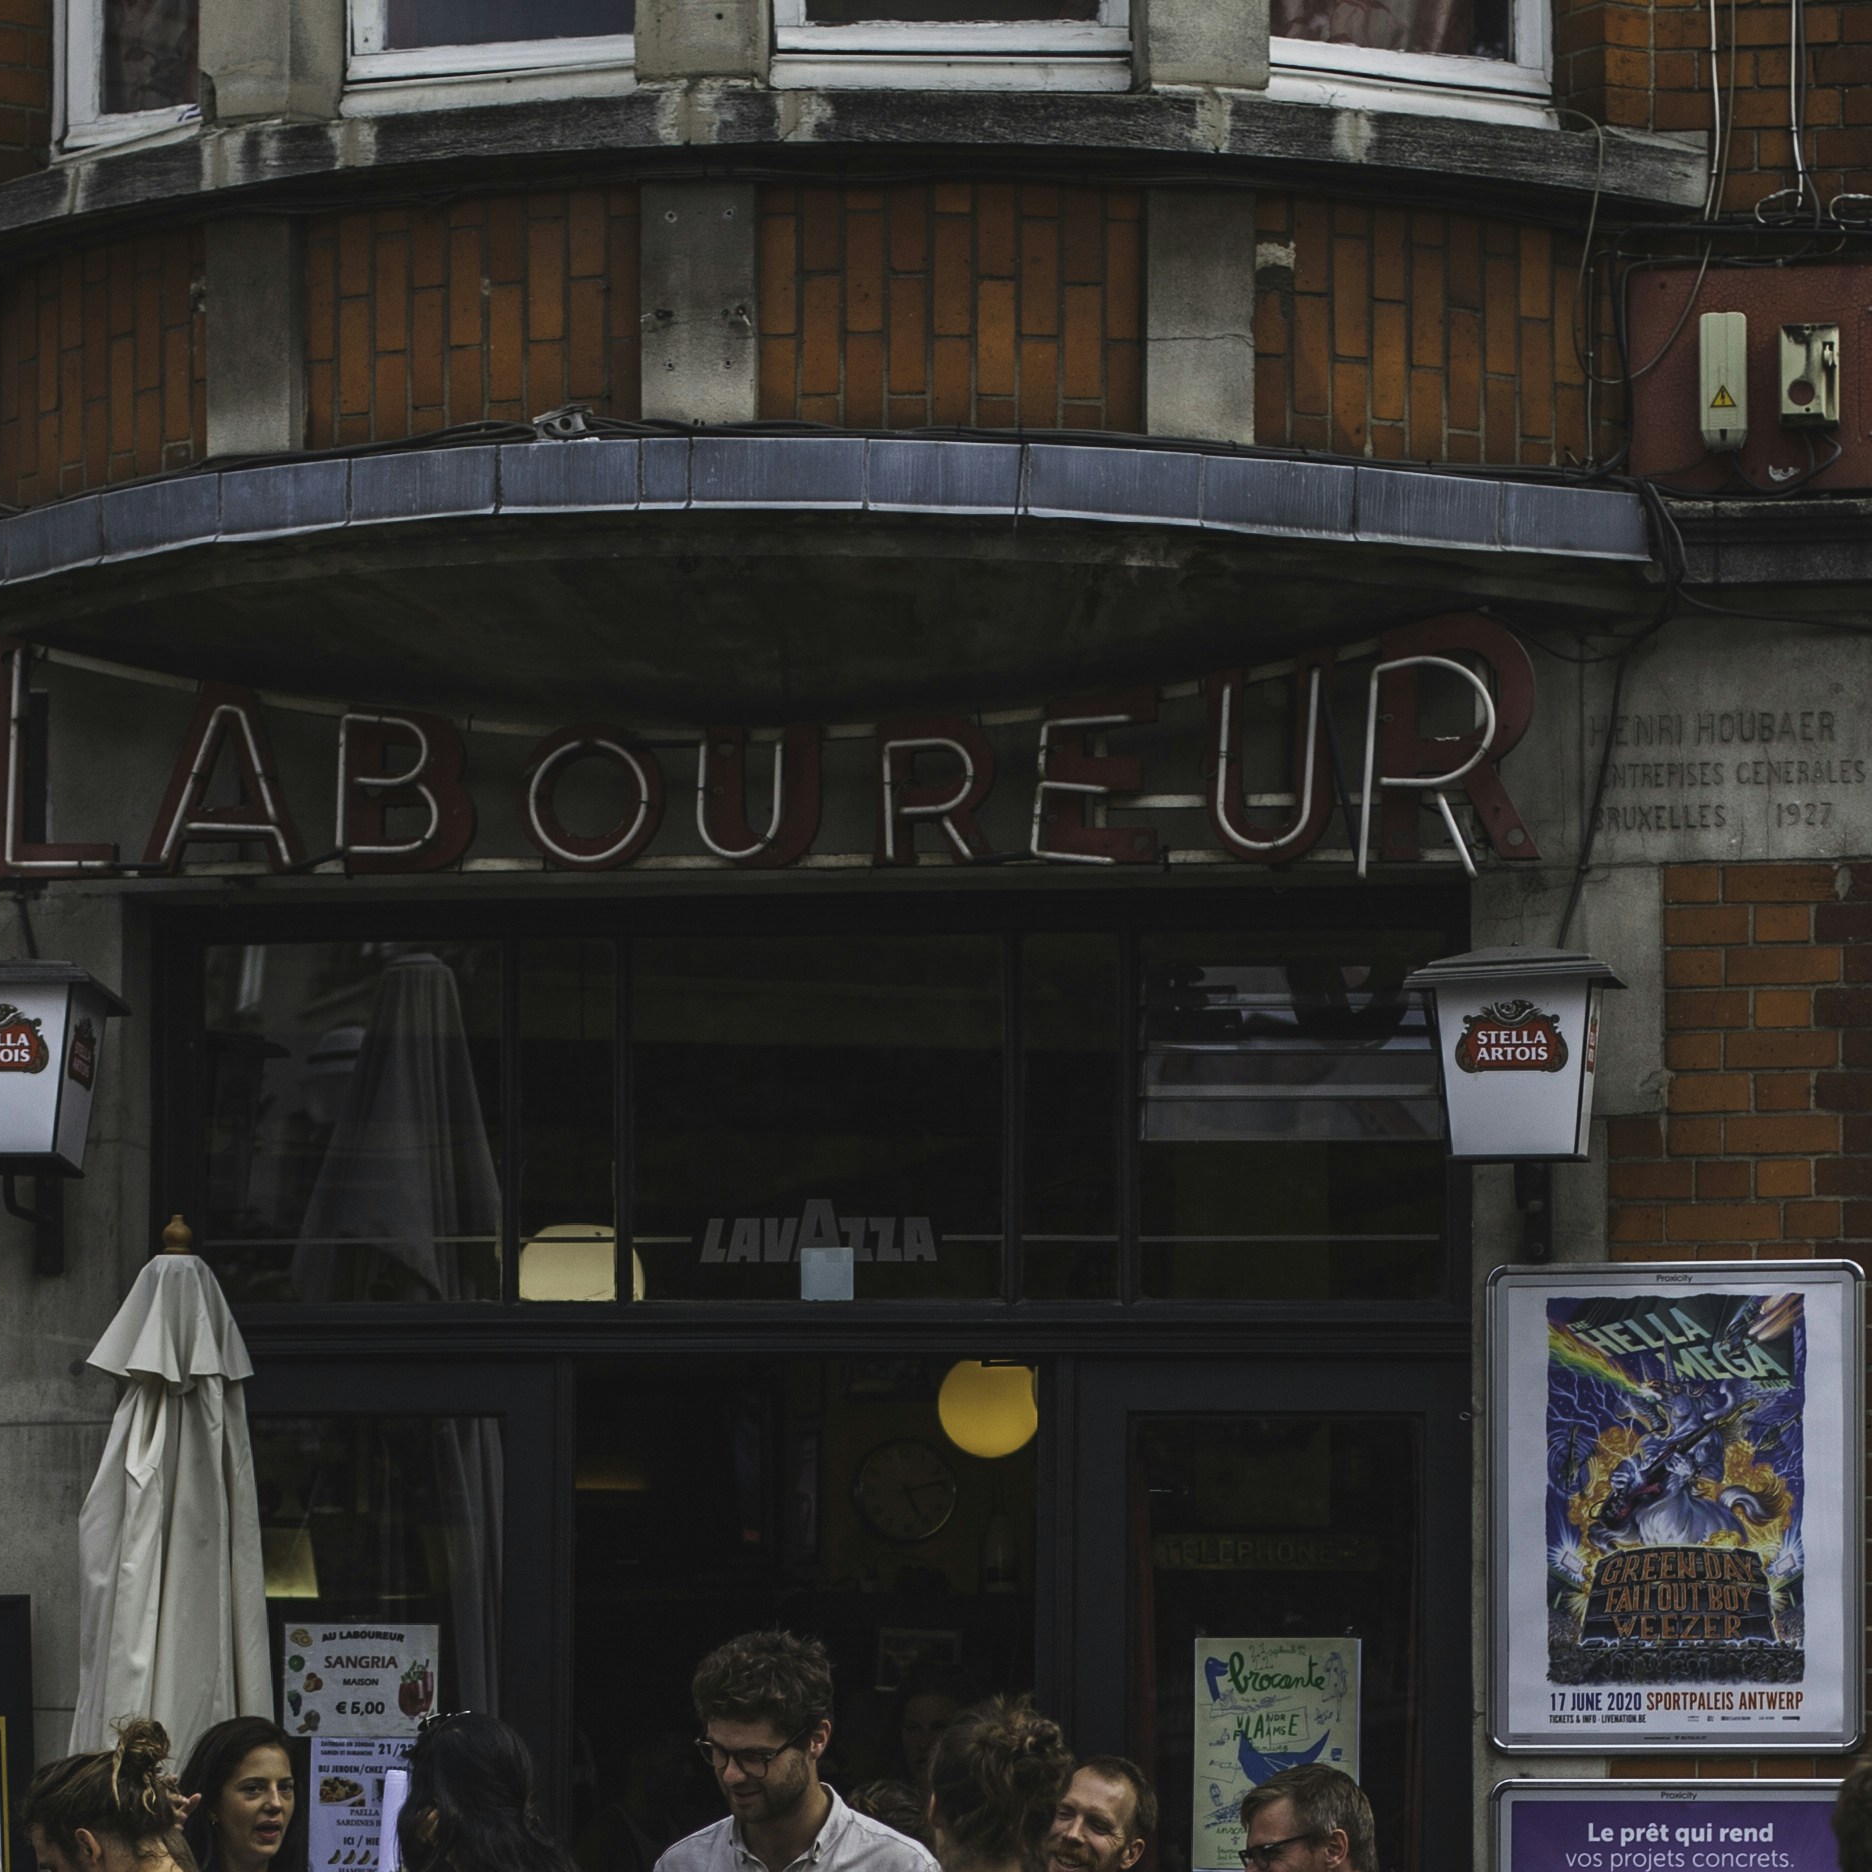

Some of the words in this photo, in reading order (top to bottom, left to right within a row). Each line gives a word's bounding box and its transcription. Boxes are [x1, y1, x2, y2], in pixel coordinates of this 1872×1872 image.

[1589, 713, 1683, 747] HENRI
[1697, 710, 1837, 745] HOUBAER
[1736, 759, 1867, 785] GENERALES
[1594, 803, 1727, 832] BRUXELLES
[1776, 802, 1832, 828] 1927
[1477, 1030, 1548, 1044] STELLA
[1477, 1046, 1548, 1061] ARTOIS
[699, 1199, 938, 1264] LAVAZZA
[1656, 1273, 1693, 1284] Proxicity
[1567, 1319, 1593, 1333] THE
[1575, 1307, 1712, 1357] HELLA
[1655, 1339, 1790, 1381] MEGA
[1754, 1377, 1796, 1390] TOUR
[1600, 1551, 1697, 1586] GREEN
[1702, 1550, 1757, 1582] DAY
[1657, 1583, 1702, 1613] OUT
[1706, 1583, 1752, 1613] BOY
[1612, 1613, 1742, 1640] WEEZER
[322, 1631, 337, 1642] AU
[339, 1630, 405, 1642] LABOUREUR
[324, 1656, 399, 1669] SANGRIA
[1228, 1651, 1325, 1694] brocante
[343, 1678, 379, 1686] MAISON
[1550, 1692, 1566, 1712] 17
[1570, 1692, 1602, 1712] JUNE
[1607, 1692, 1642, 1711] 2020
[1646, 1691, 1734, 1711] SPORTPALEIS
[1739, 1691, 1803, 1710] ANTWERP
[1549, 1714, 1574, 1724] TICKETS
[1582, 1714, 1597, 1724] INFO
[1601, 1714, 1646, 1724] LIVENATION.BE
[318, 1765, 330, 1773] BIJ
[1660, 1791, 1698, 1802] Proxicity
[336, 1819, 374, 1827] SARDINES
[344, 1837, 354, 1846] ICI
[1588, 1823, 1614, 1842] Le
[1620, 1822, 1669, 1847] prêt
[1675, 1823, 1713, 1847] qui
[1719, 1823, 1774, 1842] rend
[1565, 1852, 1603, 1868] vos
[1610, 1849, 1685, 1872] projets
[1692, 1850, 1795, 1868] concrets.
